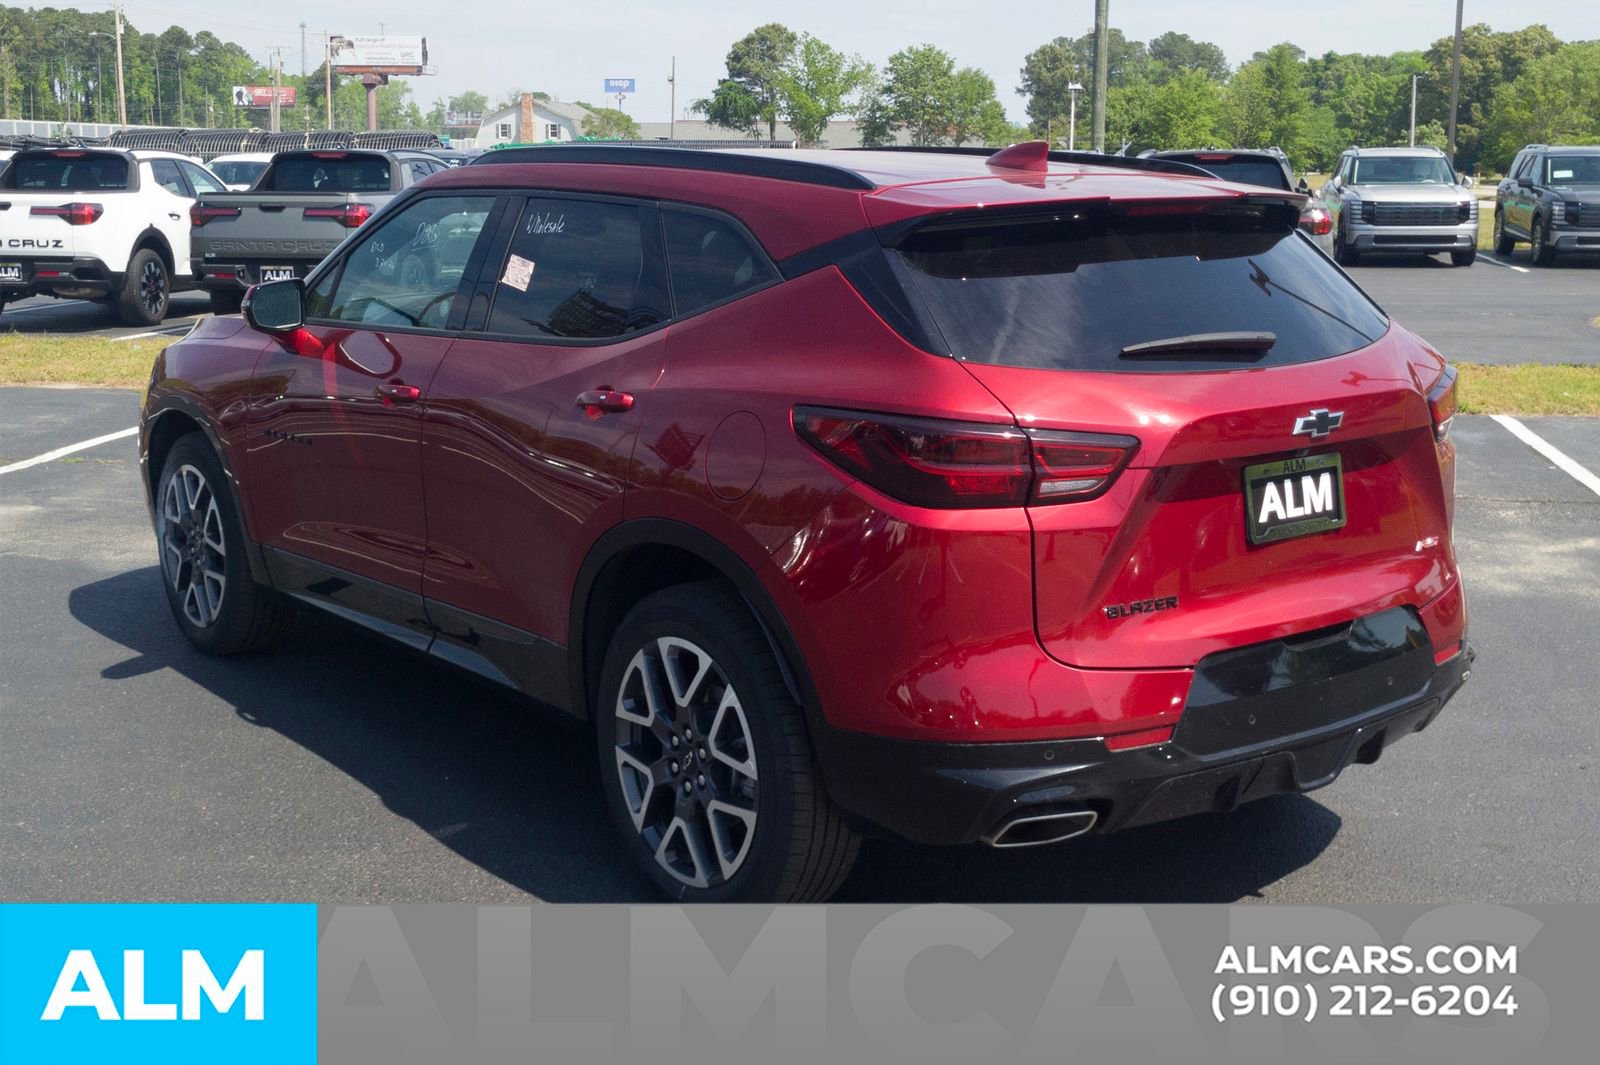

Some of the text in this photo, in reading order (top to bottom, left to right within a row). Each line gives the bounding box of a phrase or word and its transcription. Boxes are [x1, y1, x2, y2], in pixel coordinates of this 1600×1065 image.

[8, 239, 64, 248] CRUZ
[0, 267, 19, 277] LM
[263, 270, 292, 280] ALM
[1283, 459, 1306, 473] ALM
[1258, 472, 1333, 523] ALM
[1105, 595, 1179, 620] BLAZER
